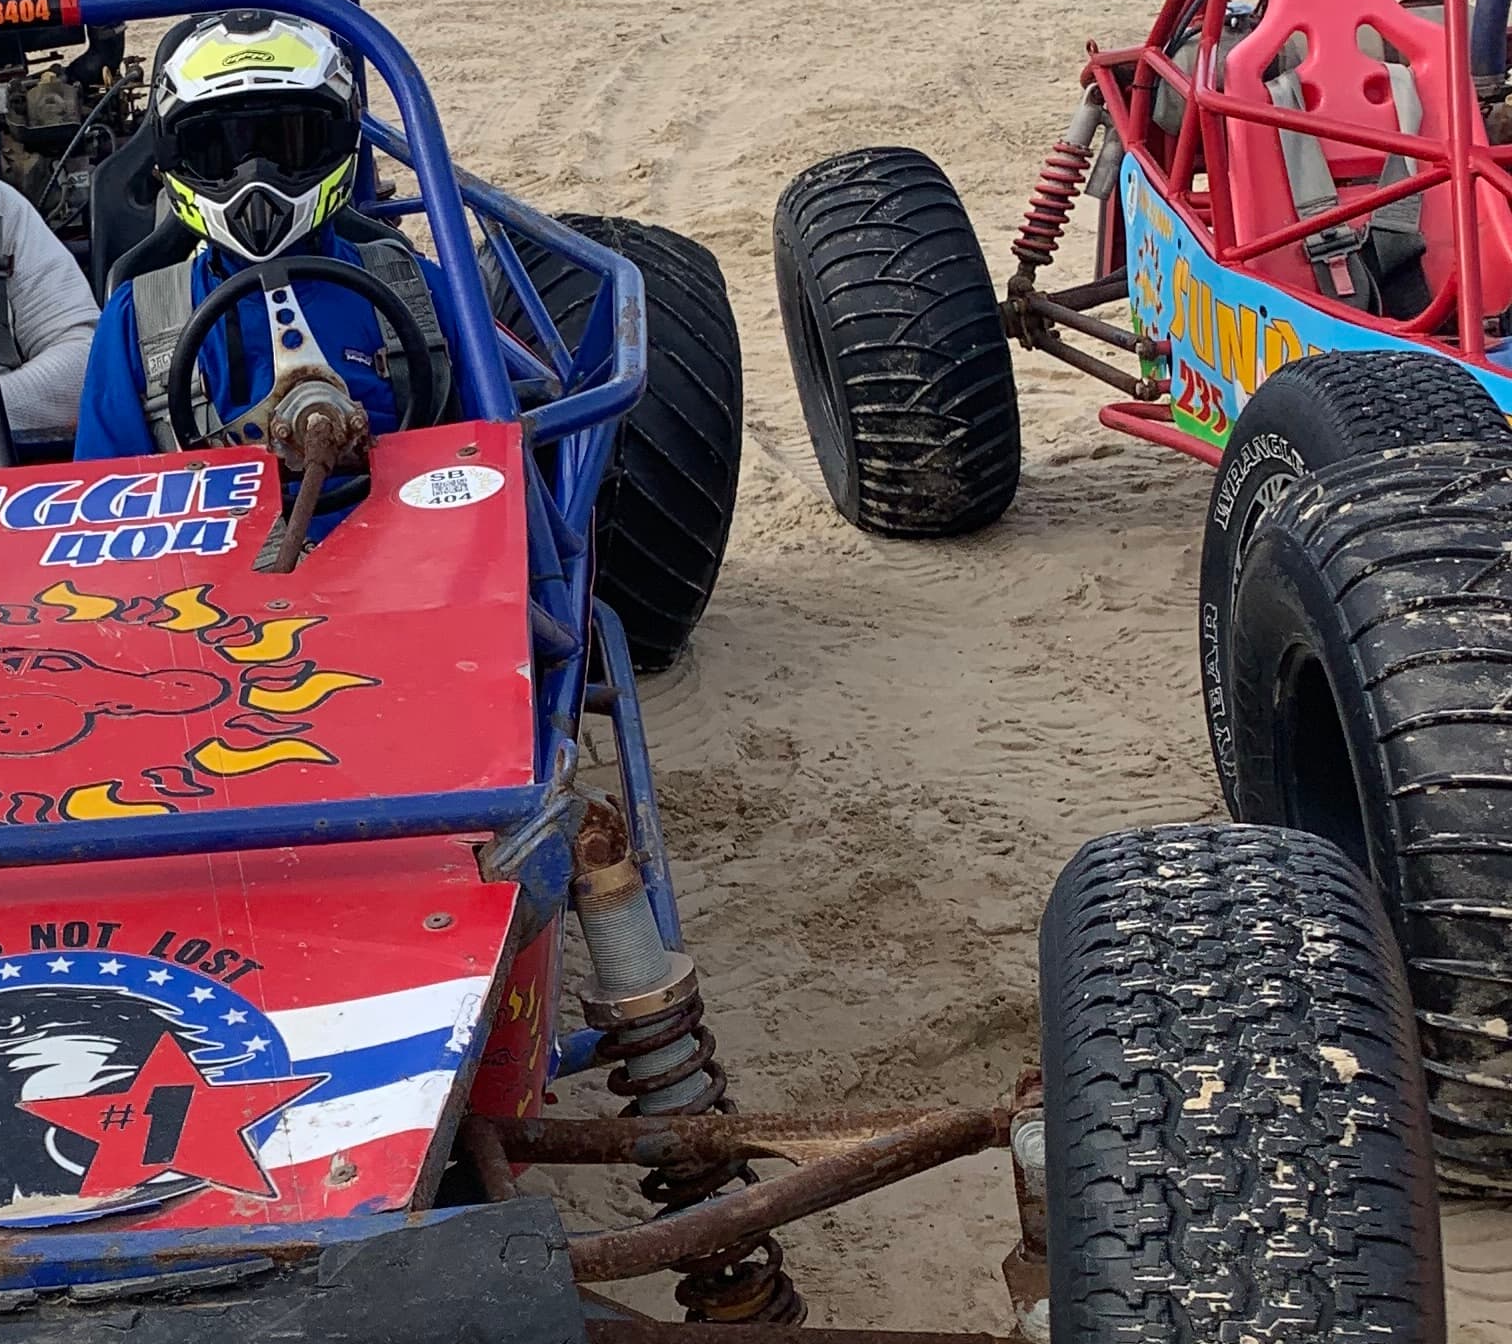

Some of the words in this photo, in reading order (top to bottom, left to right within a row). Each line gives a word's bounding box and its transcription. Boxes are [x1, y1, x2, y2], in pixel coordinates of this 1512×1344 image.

[1175, 359, 1229, 435] 235
[428, 492, 473, 505] 404
[430, 469, 465, 482] SB
[39, 517, 240, 568] 404
[29, 920, 123, 951] NOT
[148, 929, 266, 986] LOST
[100, 1084, 195, 1167] #1
